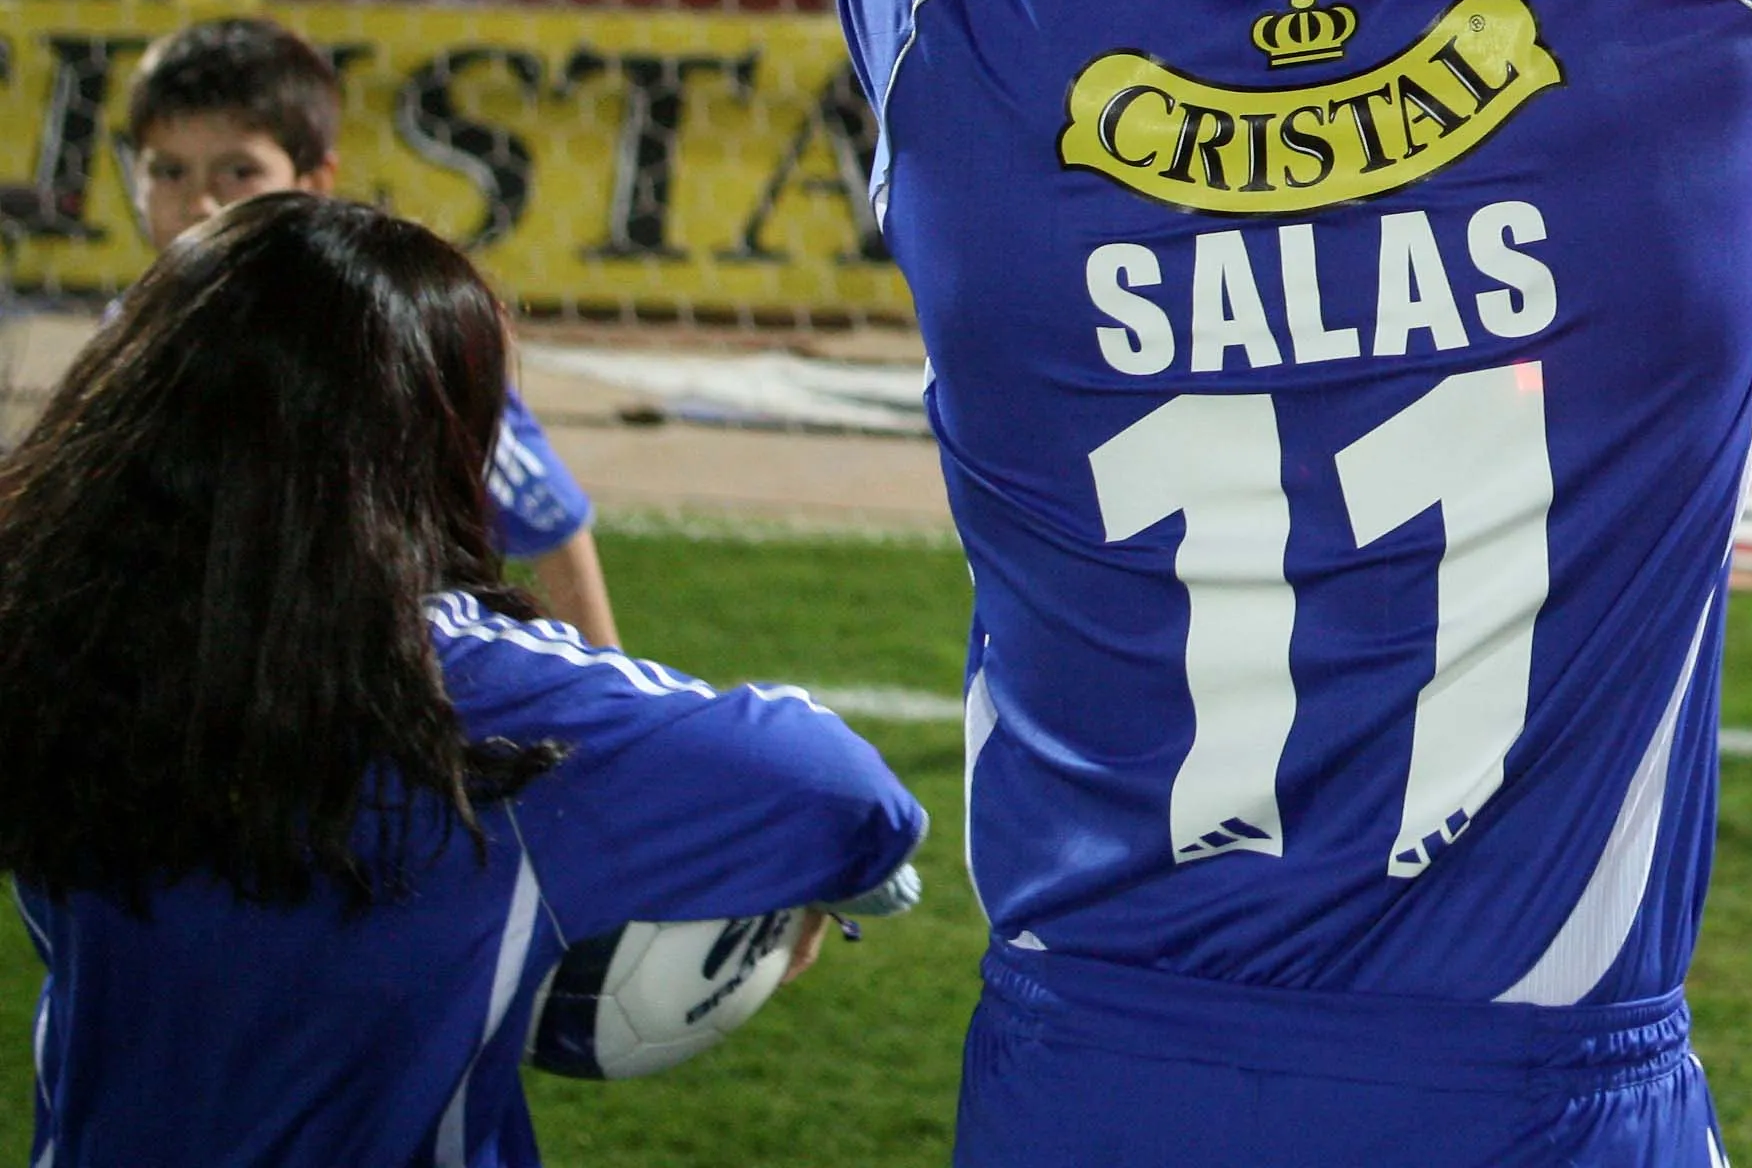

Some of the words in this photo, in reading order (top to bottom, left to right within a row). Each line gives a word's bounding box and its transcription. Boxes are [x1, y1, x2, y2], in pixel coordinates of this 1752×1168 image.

[1098, 35, 1519, 192] CRISTAL
[1084, 200, 1558, 376] SALAS
[1087, 359, 1555, 879] 11
